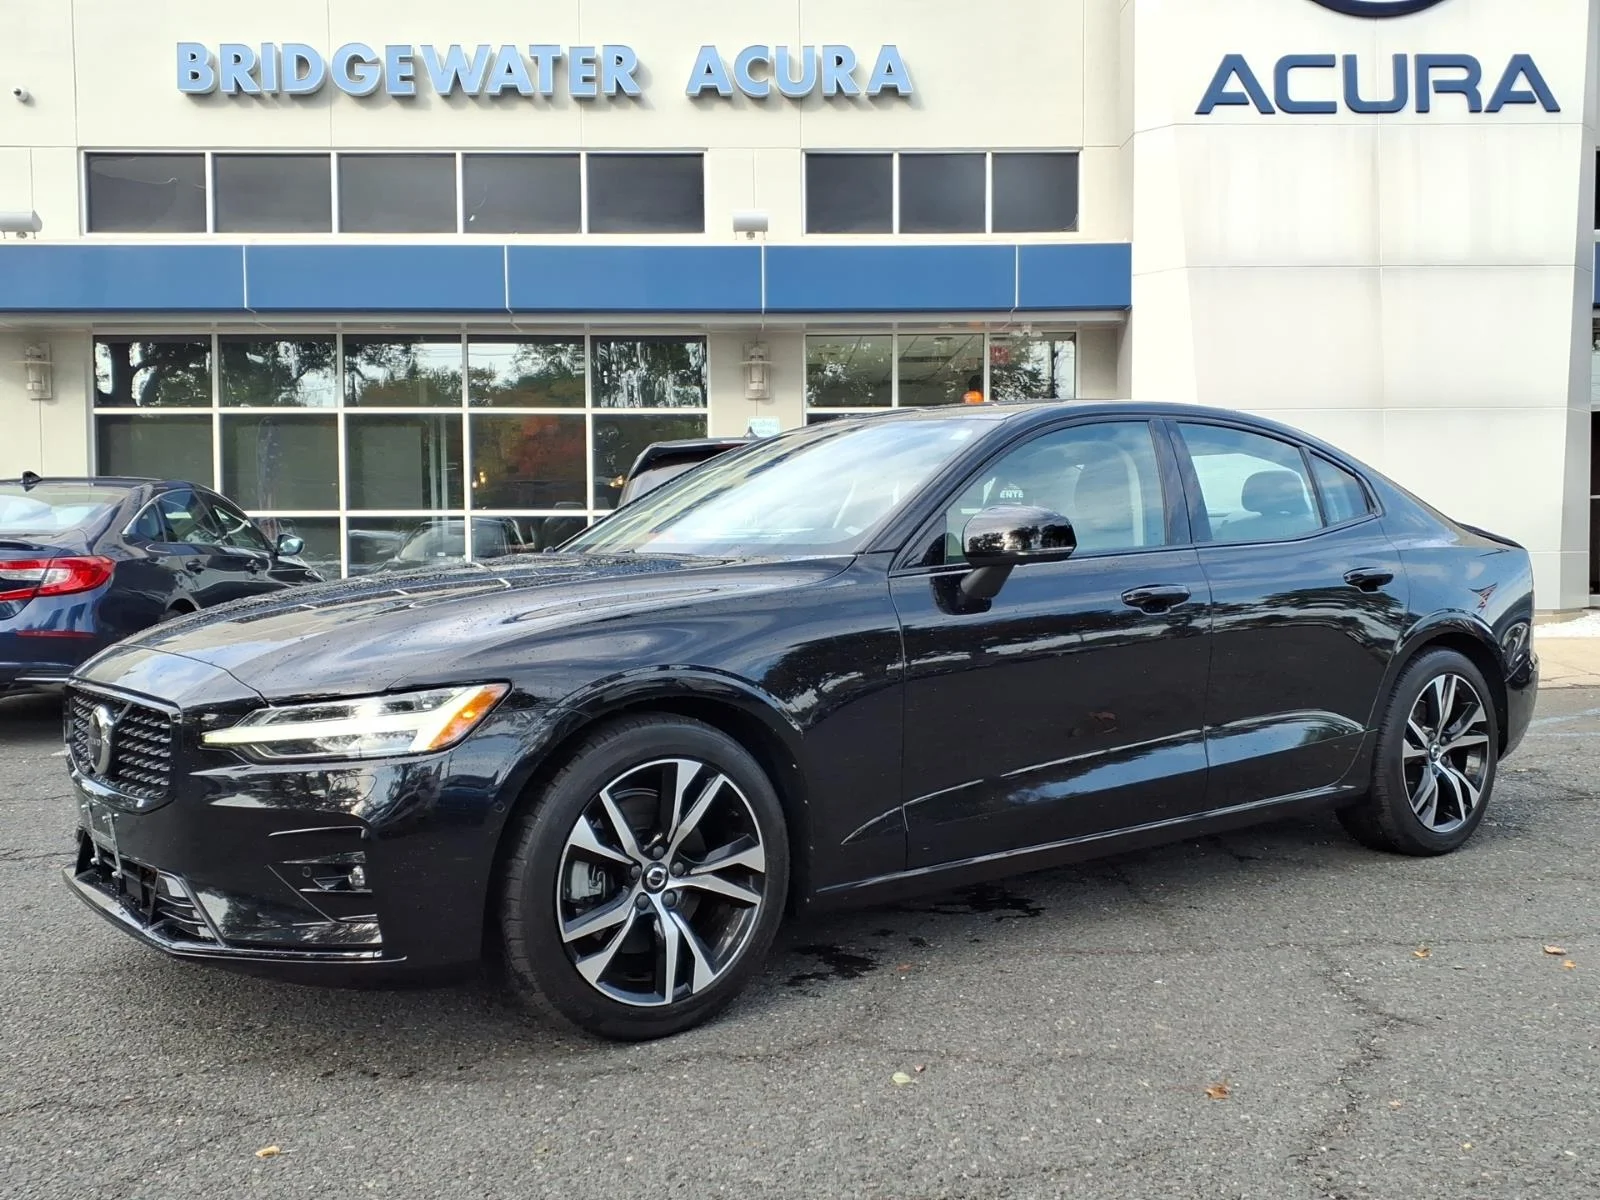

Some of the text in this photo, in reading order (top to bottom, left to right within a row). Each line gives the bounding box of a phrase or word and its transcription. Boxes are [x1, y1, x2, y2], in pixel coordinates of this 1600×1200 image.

[176, 42, 913, 98] BRIDGEWATER ACURA
[1195, 54, 1561, 114] ACURA
